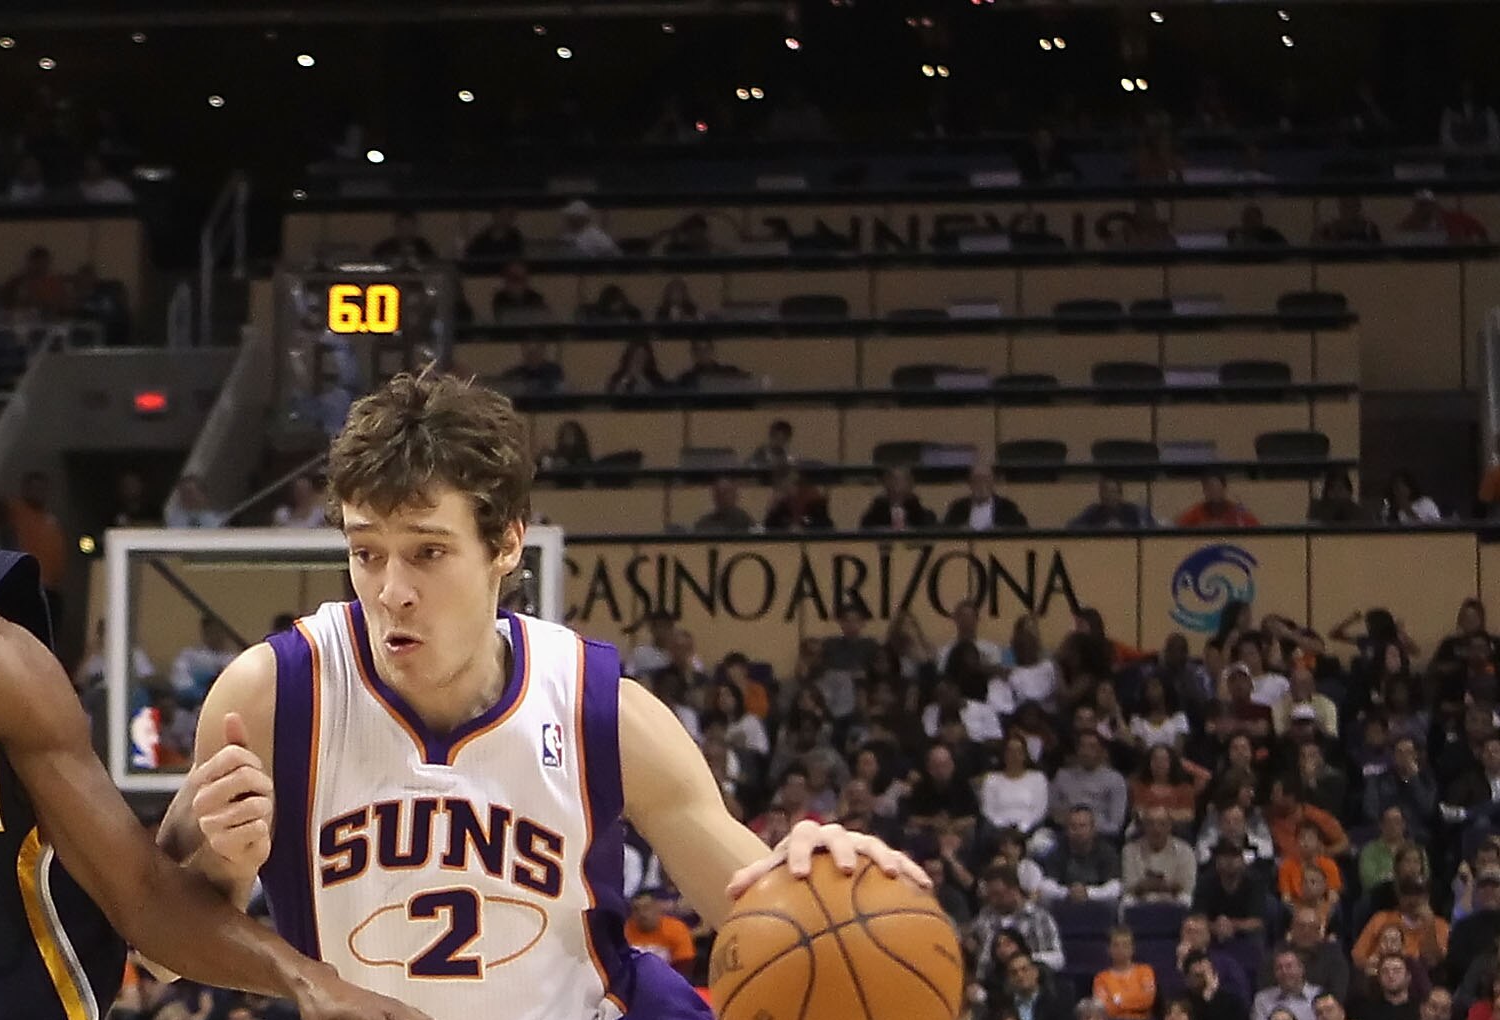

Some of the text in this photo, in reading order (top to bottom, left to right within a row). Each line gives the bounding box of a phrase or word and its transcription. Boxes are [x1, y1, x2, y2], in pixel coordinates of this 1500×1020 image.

[328, 283, 400, 333] 6.0
[784, 545, 1082, 621] ARIZONA
[319, 796, 565, 900] SUNS
[406, 886, 483, 980] 2
